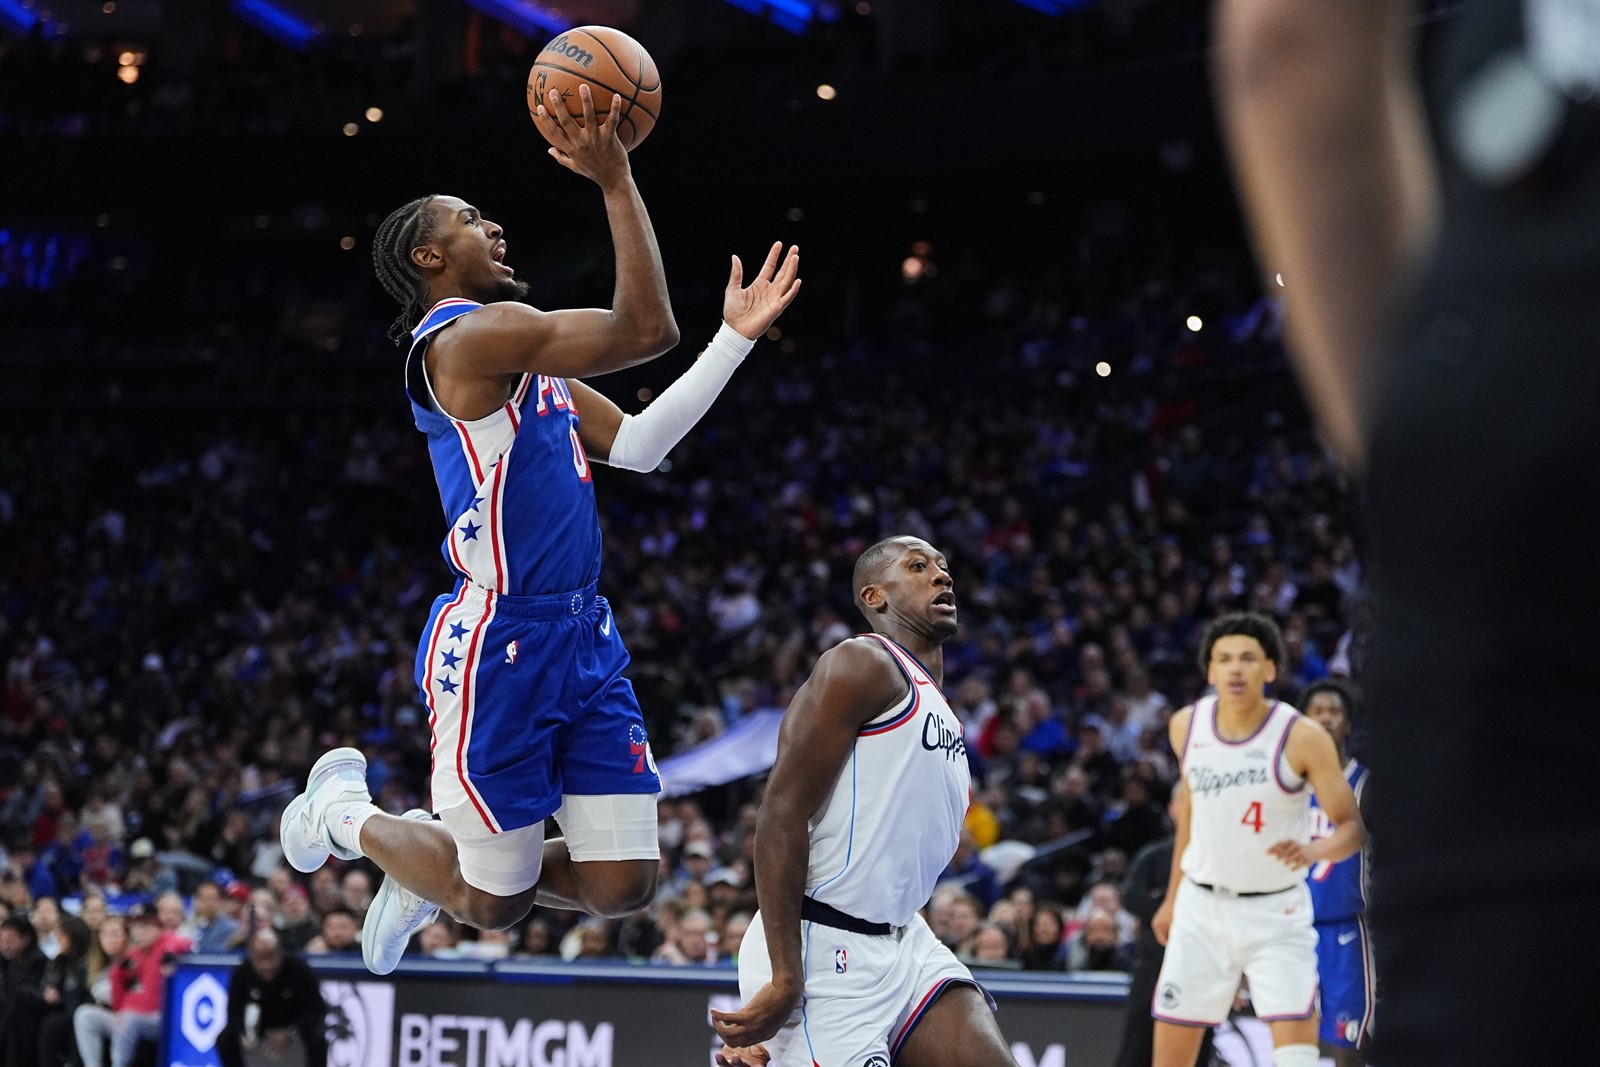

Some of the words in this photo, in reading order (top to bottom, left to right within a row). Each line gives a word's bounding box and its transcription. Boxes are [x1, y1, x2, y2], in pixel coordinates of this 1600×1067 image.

[1188, 766, 1267, 799] Clippers
[1241, 801, 1266, 834] 4
[400, 1013, 614, 1067] BETMGM
